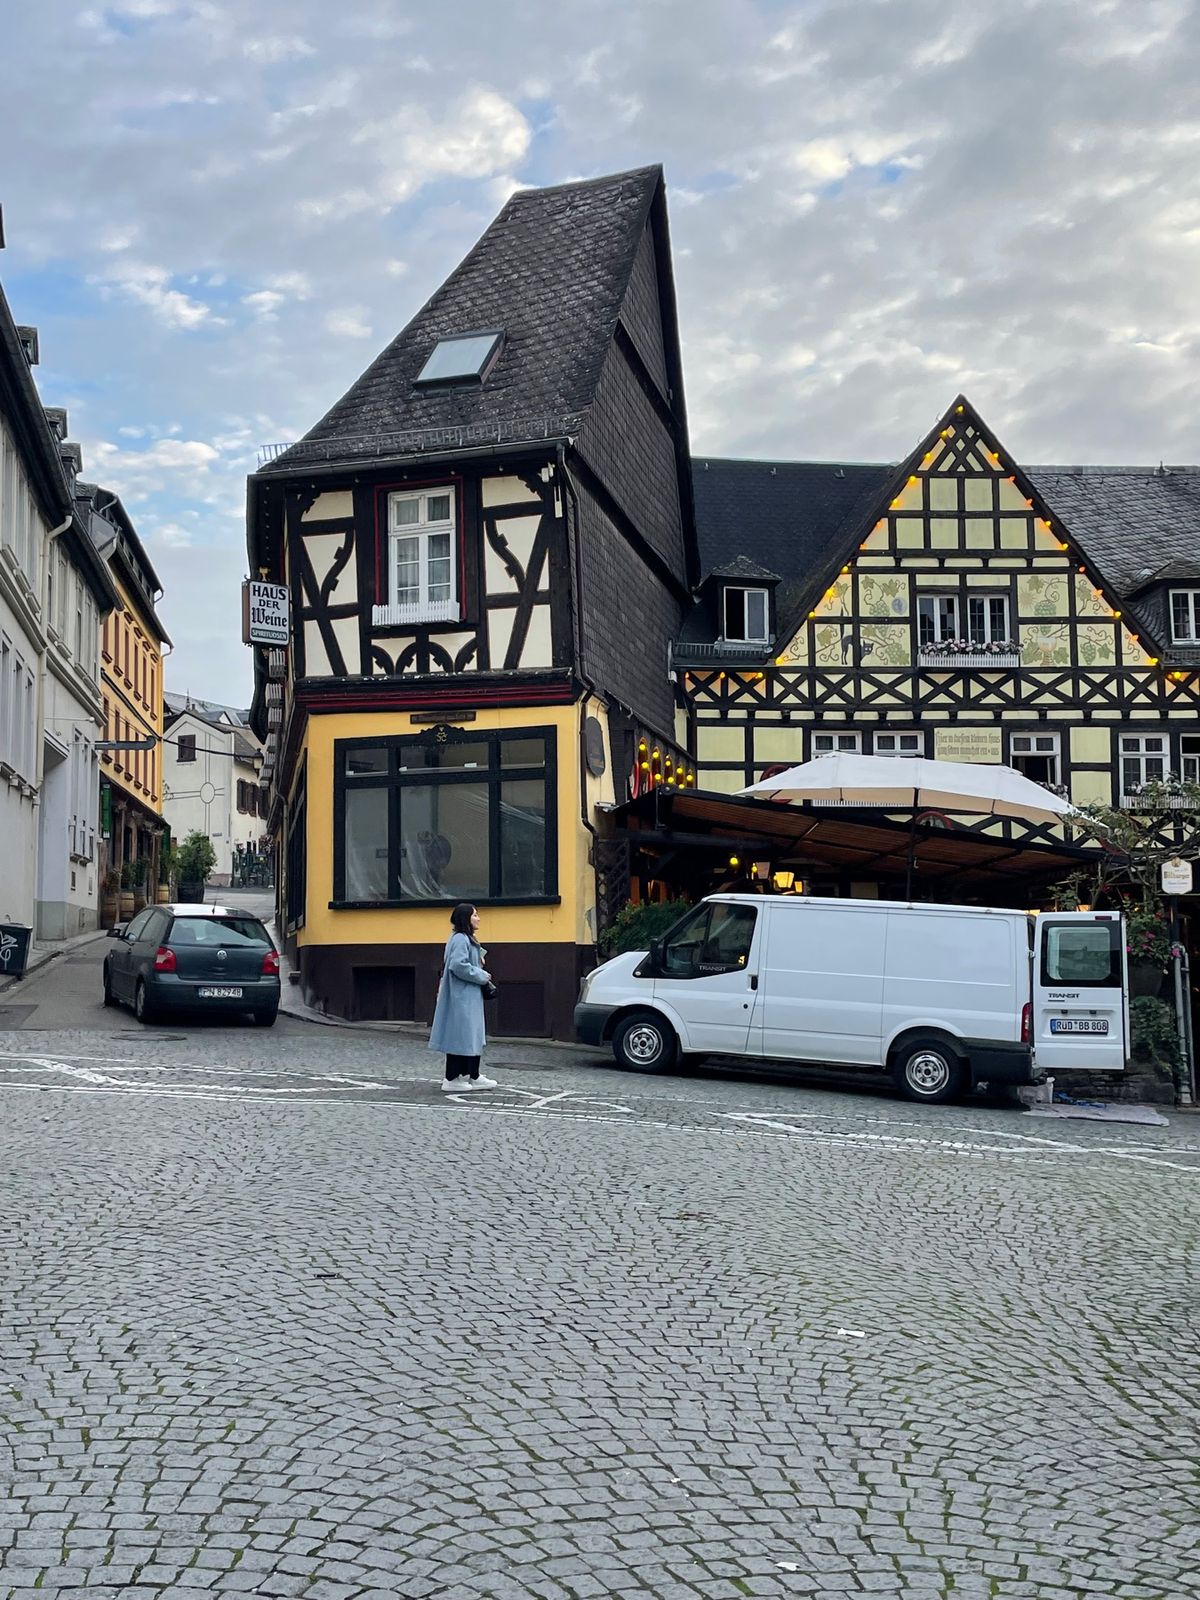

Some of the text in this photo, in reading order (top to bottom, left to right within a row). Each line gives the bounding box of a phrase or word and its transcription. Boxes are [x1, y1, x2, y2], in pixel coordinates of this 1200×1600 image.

[252, 584, 286, 600] HAUS
[259, 598, 280, 610] DER
[251, 607, 287, 627] Weine
[1078, 1021, 1090, 1031] BB
[1091, 1021, 1108, 1031] 808
